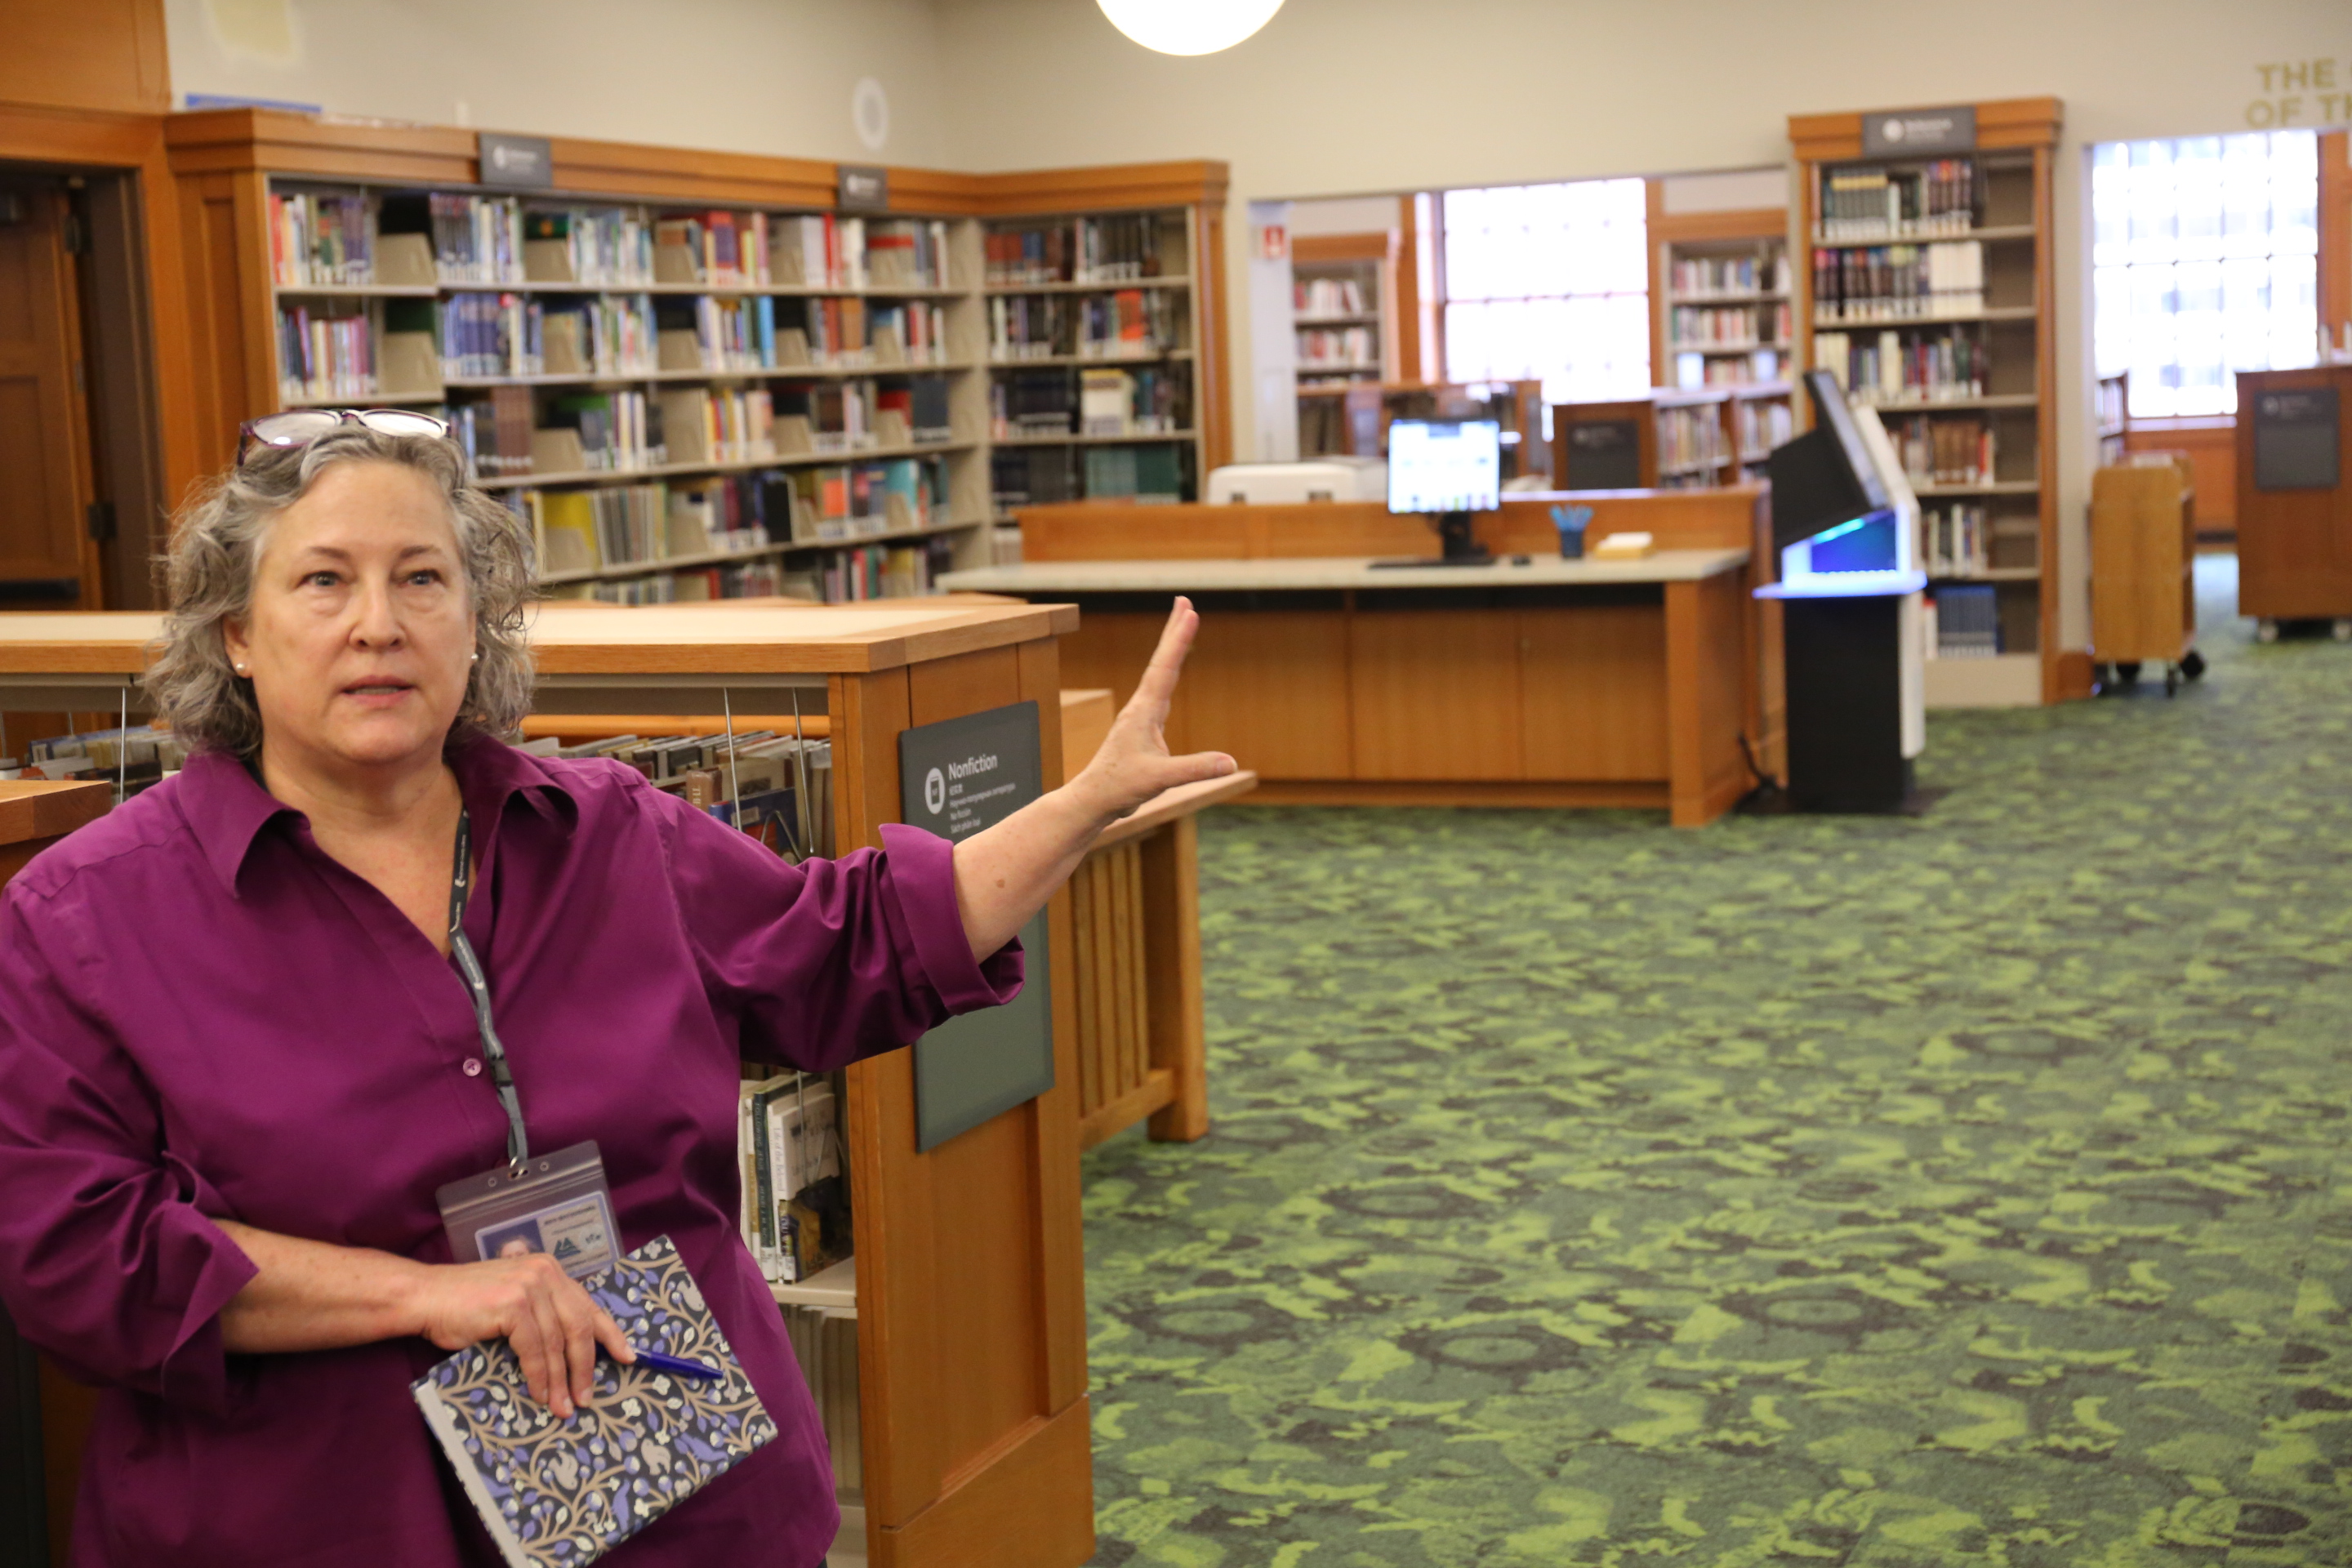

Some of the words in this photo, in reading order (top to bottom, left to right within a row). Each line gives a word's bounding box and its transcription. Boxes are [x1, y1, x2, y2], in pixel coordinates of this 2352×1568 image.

[2255, 57, 2336, 92] THE
[2245, 96, 2302, 129] OF
[948, 755, 998, 781] Nonfiction
[755, 1102, 763, 1147] FOLLOWING
